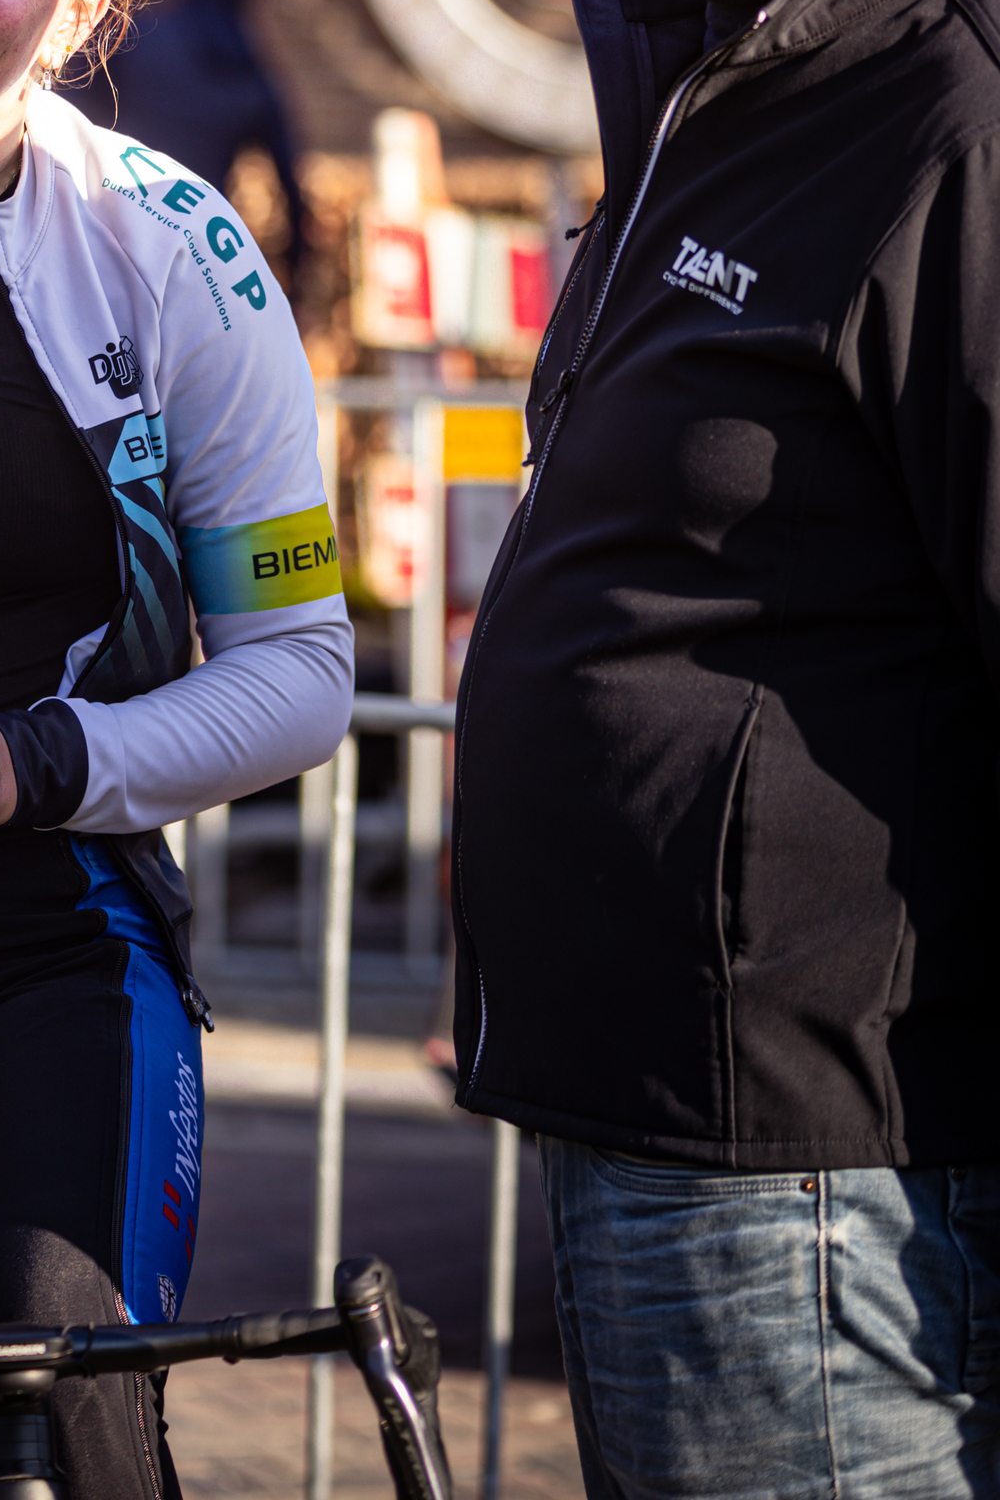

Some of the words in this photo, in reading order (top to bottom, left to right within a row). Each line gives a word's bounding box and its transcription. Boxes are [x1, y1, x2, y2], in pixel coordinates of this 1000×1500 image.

[101, 177, 136, 201] Dutch
[138, 199, 181, 231] Service
[183, 229, 207, 266] Cloud
[202, 267, 232, 332] Solutions
